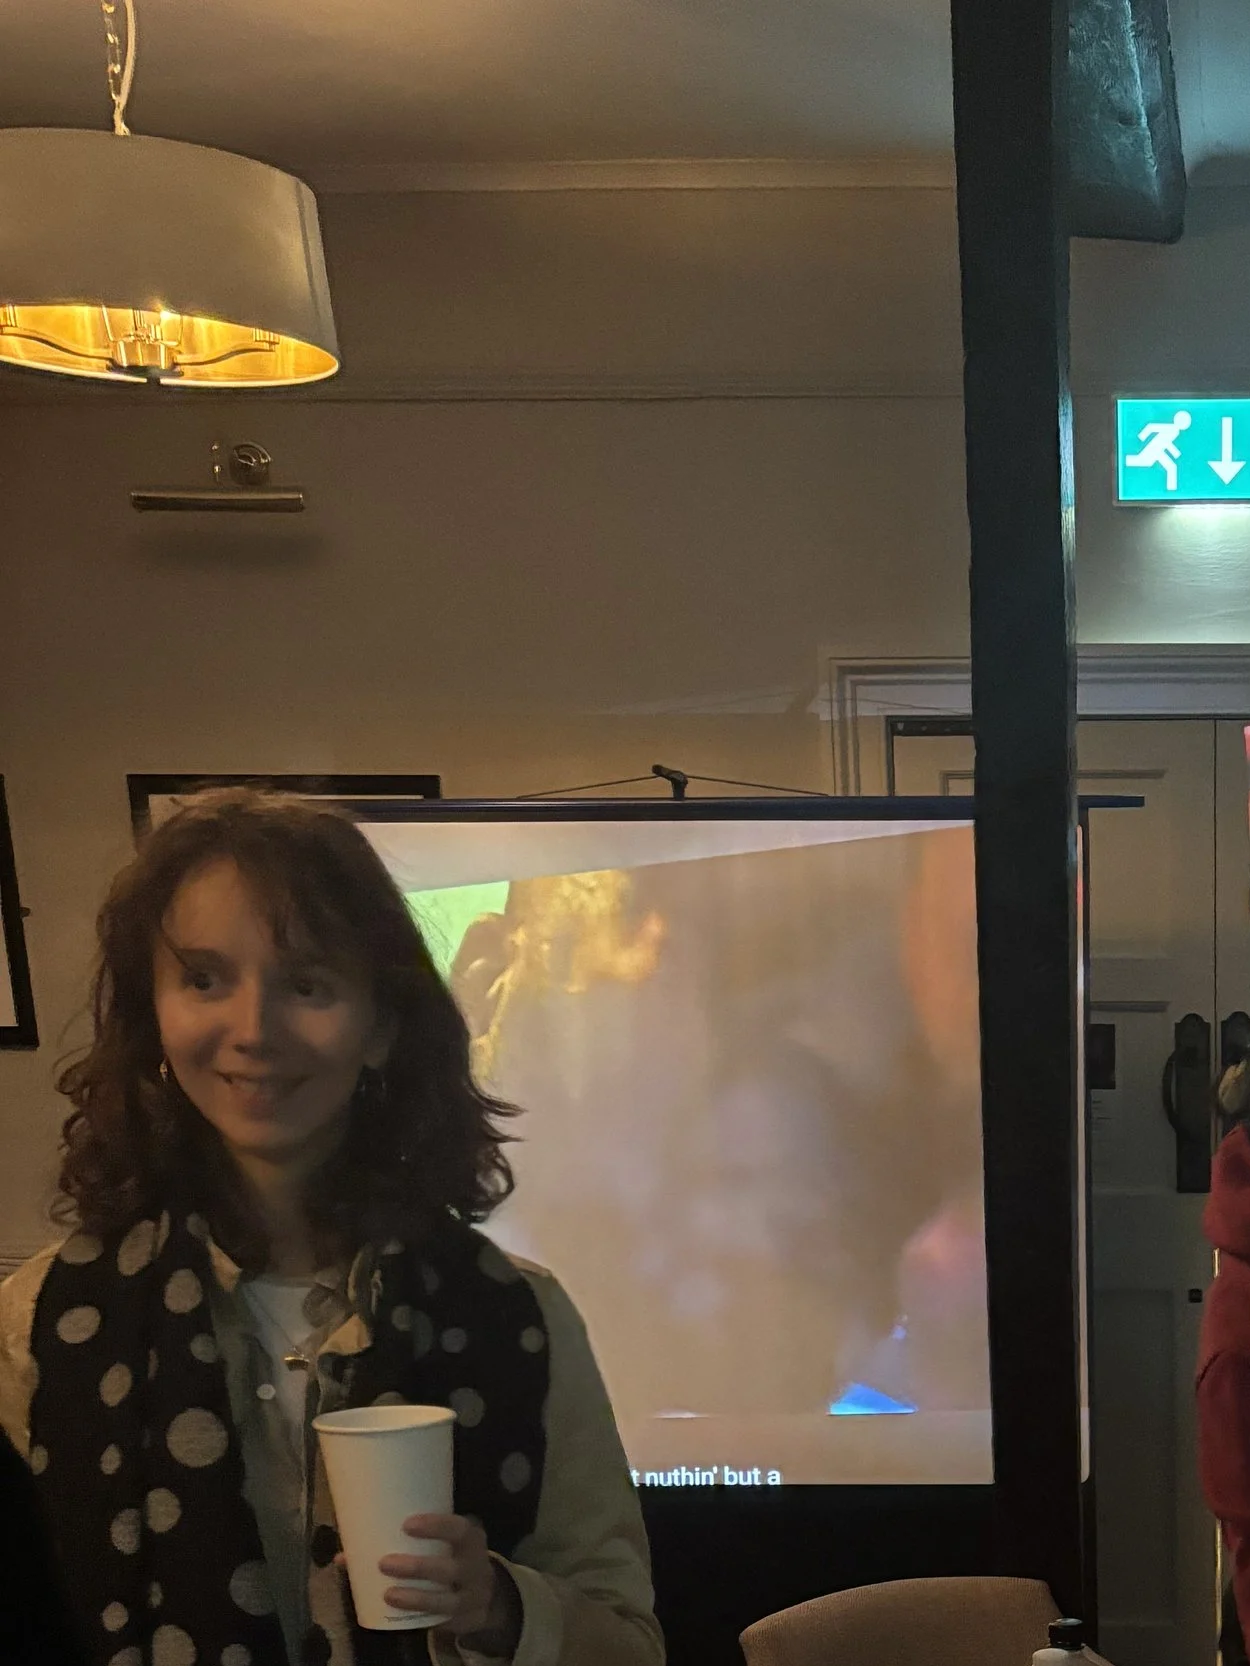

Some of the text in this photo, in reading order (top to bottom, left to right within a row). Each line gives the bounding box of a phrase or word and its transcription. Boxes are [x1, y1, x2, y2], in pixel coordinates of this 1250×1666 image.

[645, 1465, 718, 1487] nuthin'
[724, 1465, 761, 1487] but
[767, 1470, 781, 1486] a
